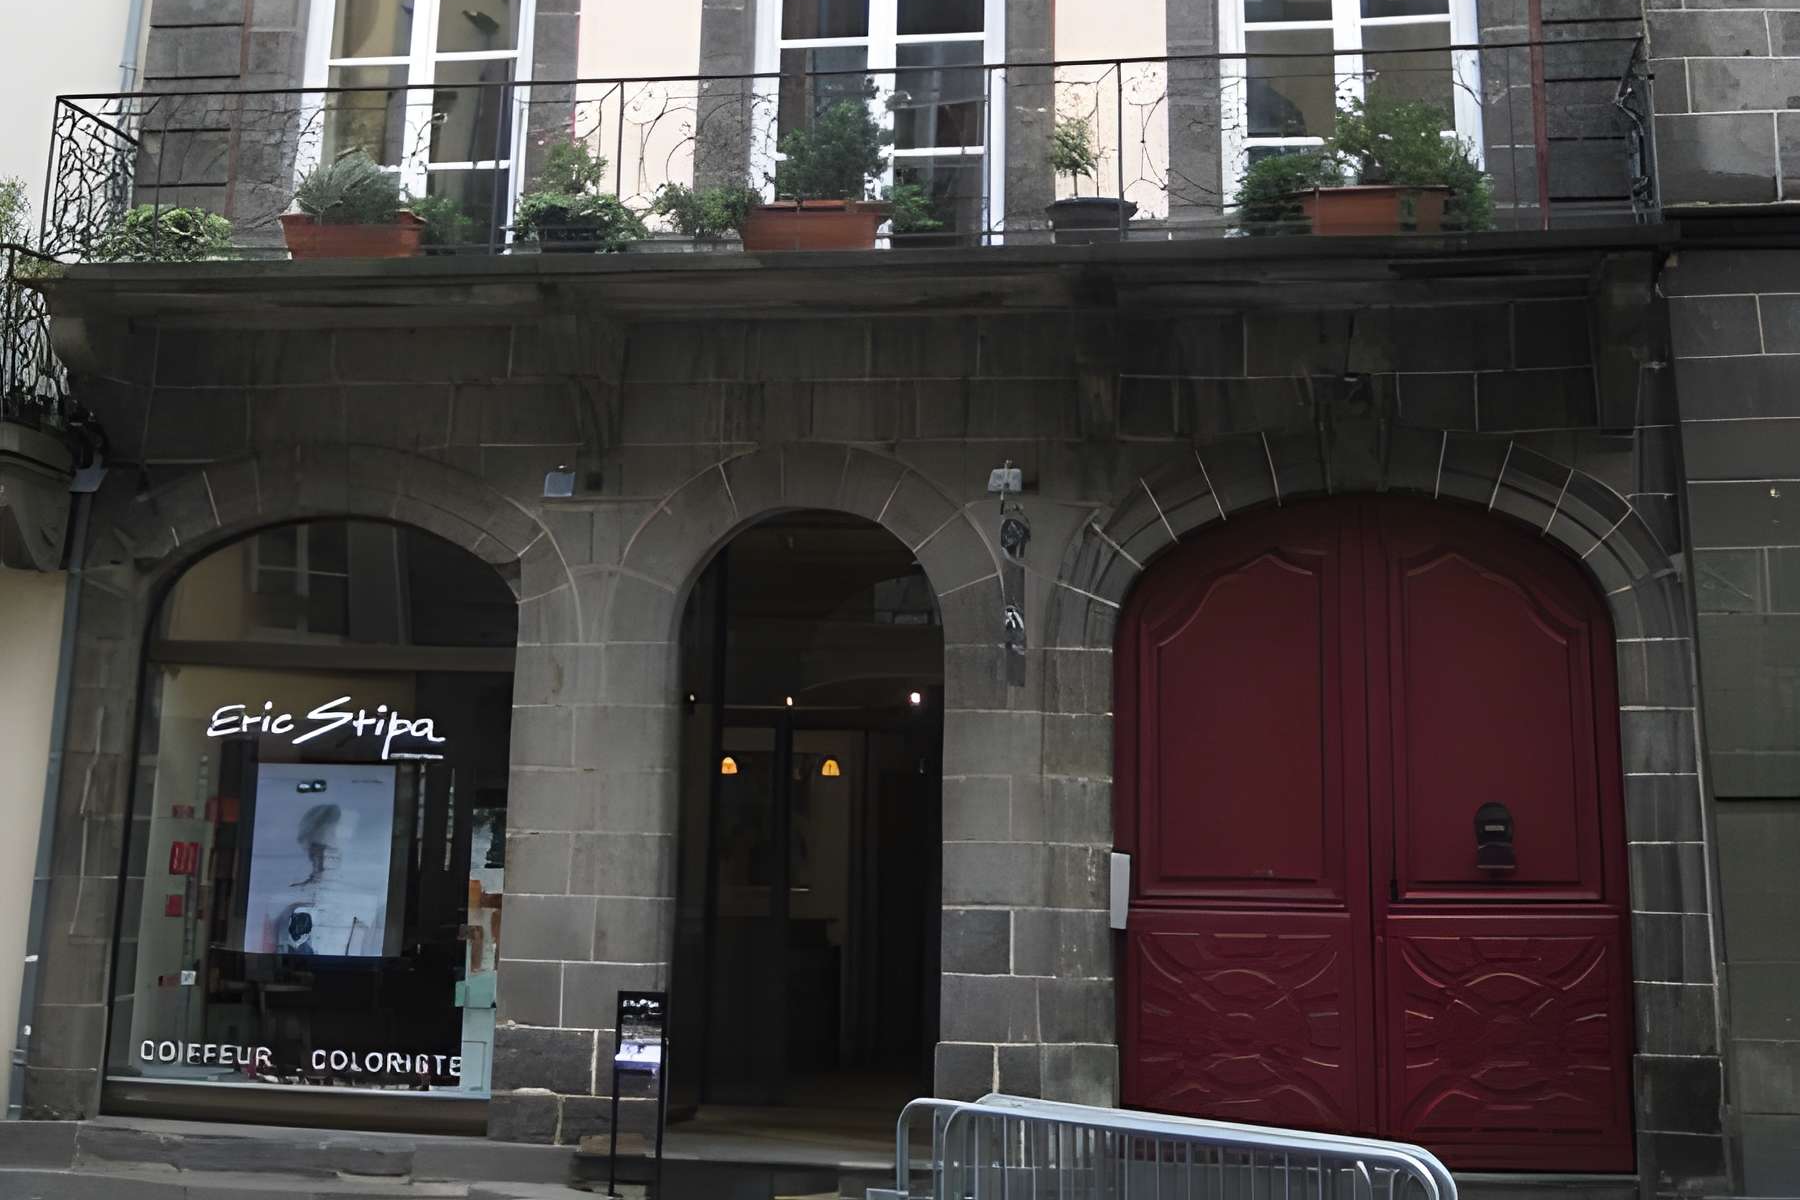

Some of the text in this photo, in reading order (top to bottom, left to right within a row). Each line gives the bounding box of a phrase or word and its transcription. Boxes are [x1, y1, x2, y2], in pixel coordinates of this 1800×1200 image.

[207, 696, 446, 760] Eric Stipa
[140, 1039, 462, 1077] COIFFEUR COLORISTE
